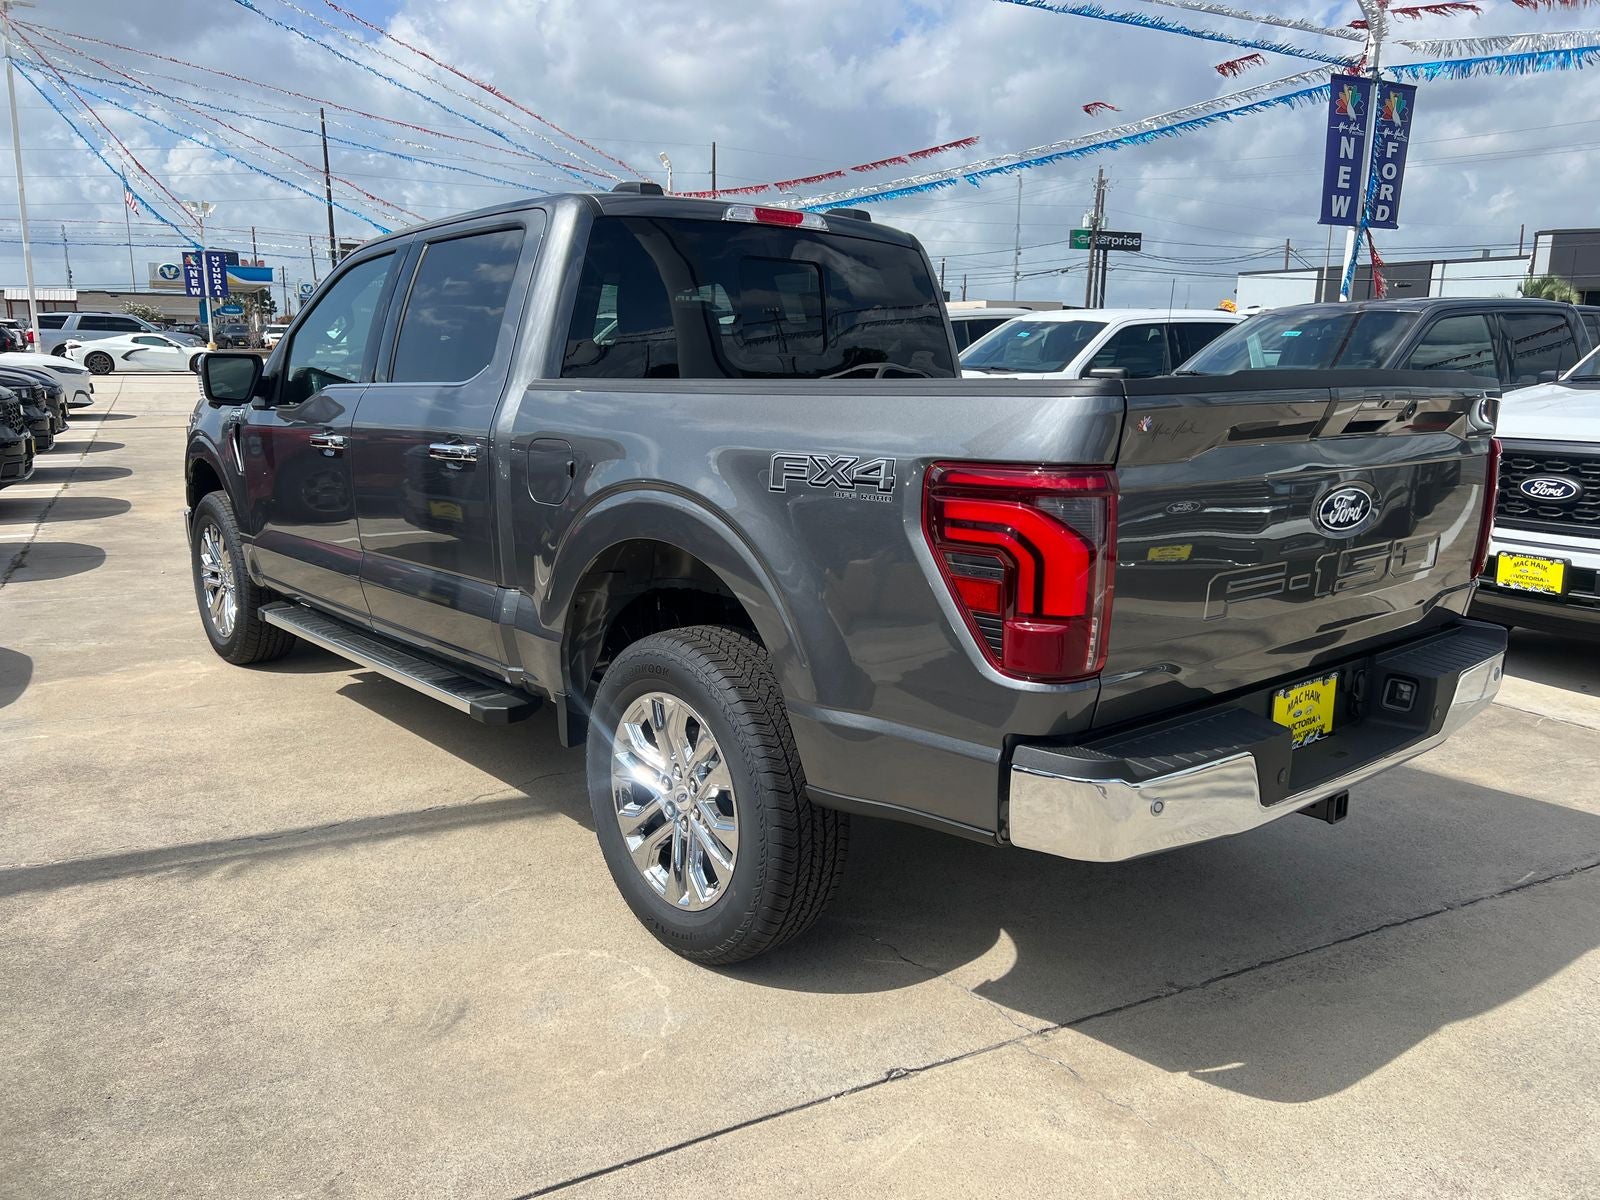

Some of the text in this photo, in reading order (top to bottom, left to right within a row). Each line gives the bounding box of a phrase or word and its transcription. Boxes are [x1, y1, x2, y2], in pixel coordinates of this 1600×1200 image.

[1331, 136, 1355, 218] NEW
[1375, 141, 1399, 222] FORD
[189, 270, 201, 295] NEW
[211, 256, 222, 296] HYUNDAI
[768, 452, 897, 494] FX4
[834, 491, 893, 503] OFF ROAD
[1530, 480, 1566, 497] Ford
[1329, 494, 1364, 524] Ford
[1203, 531, 1441, 622] F-150
[1513, 560, 1549, 573] MAC HAIK
[1515, 573, 1544, 583] VICTORIA
[1287, 690, 1321, 715] MAC HAIK
